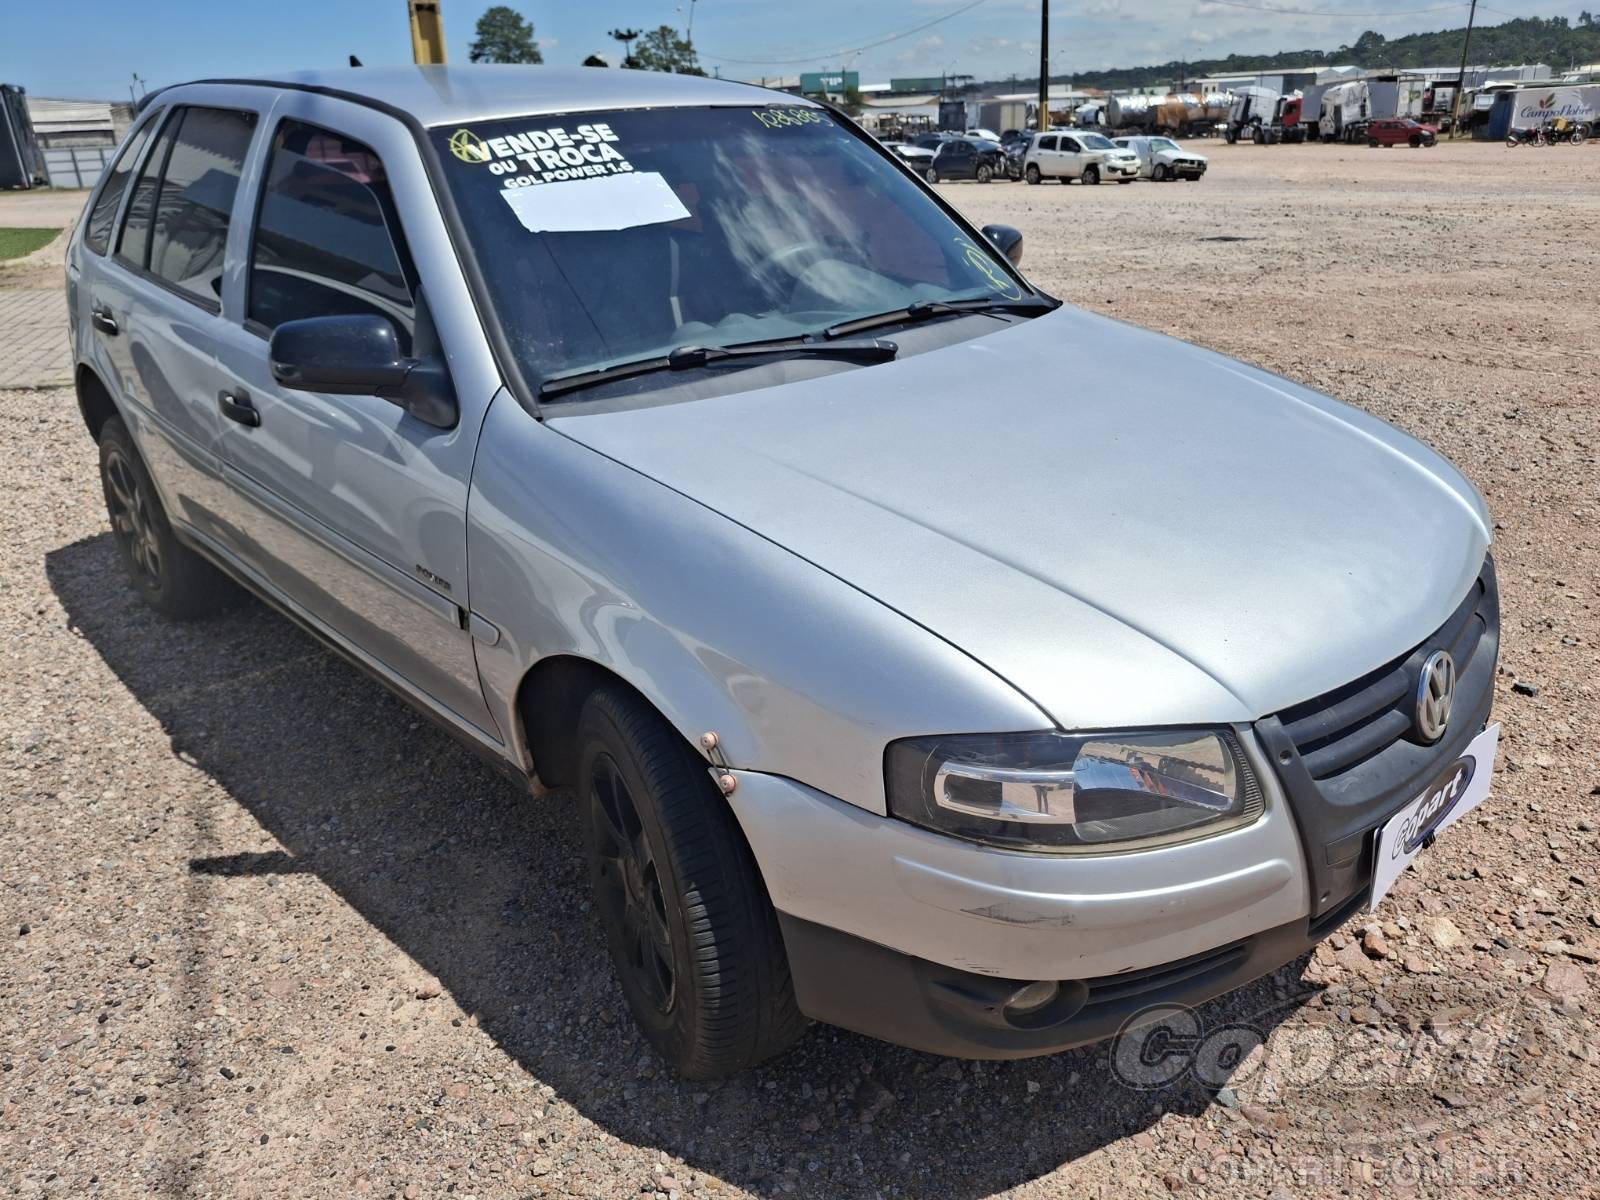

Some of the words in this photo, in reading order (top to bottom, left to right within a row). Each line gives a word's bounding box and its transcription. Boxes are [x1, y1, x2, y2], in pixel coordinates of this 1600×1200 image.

[465, 123, 620, 162] VENDE-SE
[489, 159, 517, 176] OU
[516, 142, 625, 172] TROCA
[503, 176, 544, 189] GOL
[542, 163, 608, 183] POWER
[607, 161, 634, 173] 1.6
[1392, 768, 1463, 859] Copart
